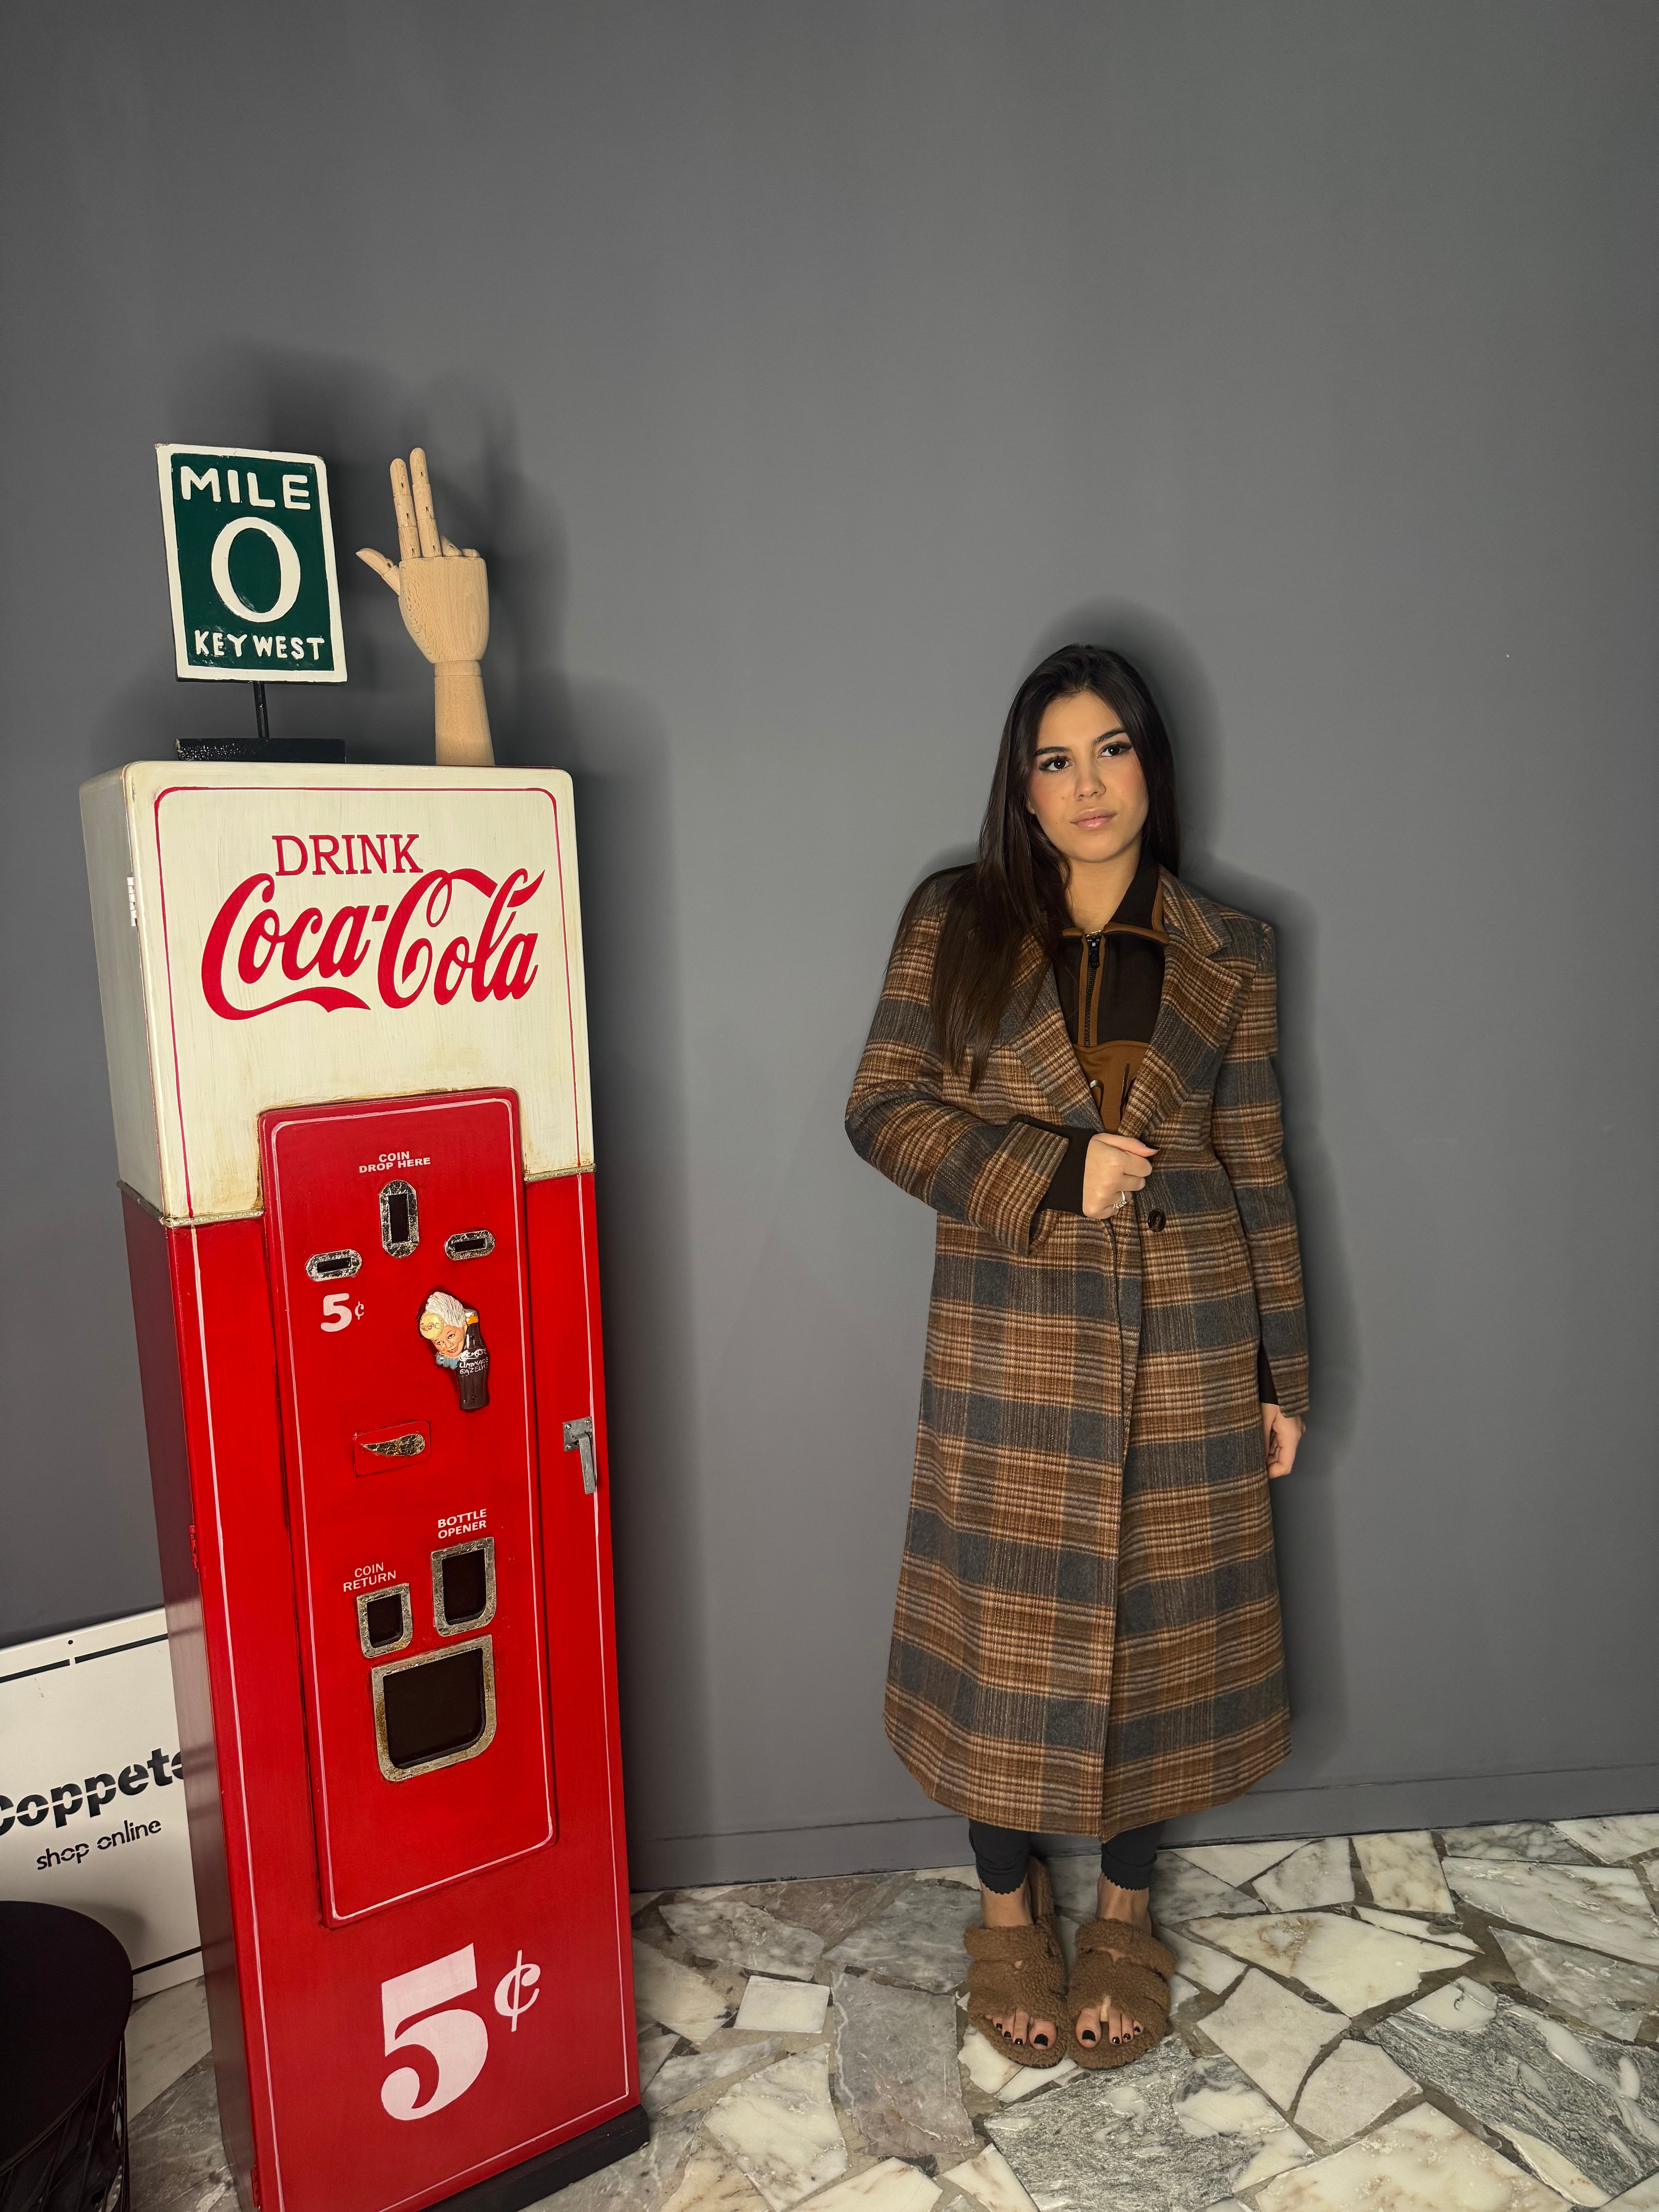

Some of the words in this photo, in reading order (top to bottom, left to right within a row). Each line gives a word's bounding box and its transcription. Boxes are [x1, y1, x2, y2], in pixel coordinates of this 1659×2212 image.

[180, 466, 311, 510] MILE
[194, 630, 248, 657] KEY
[253, 635, 325, 660] WEST
[272, 834, 423, 876] DRINK
[201, 868, 545, 1020] Coca-Cola
[359, 1162, 394, 1173] DROP
[397, 1157, 431, 1169] HERE
[378, 1150, 410, 1163] COIN
[437, 1508, 487, 1529] BOTTLE
[438, 1519, 487, 1539] OPENER
[343, 1570, 397, 1592] RETURN
[354, 1562, 384, 1578] COIN
[36, 1842, 90, 1870] shop
[96, 1819, 162, 1850] online
